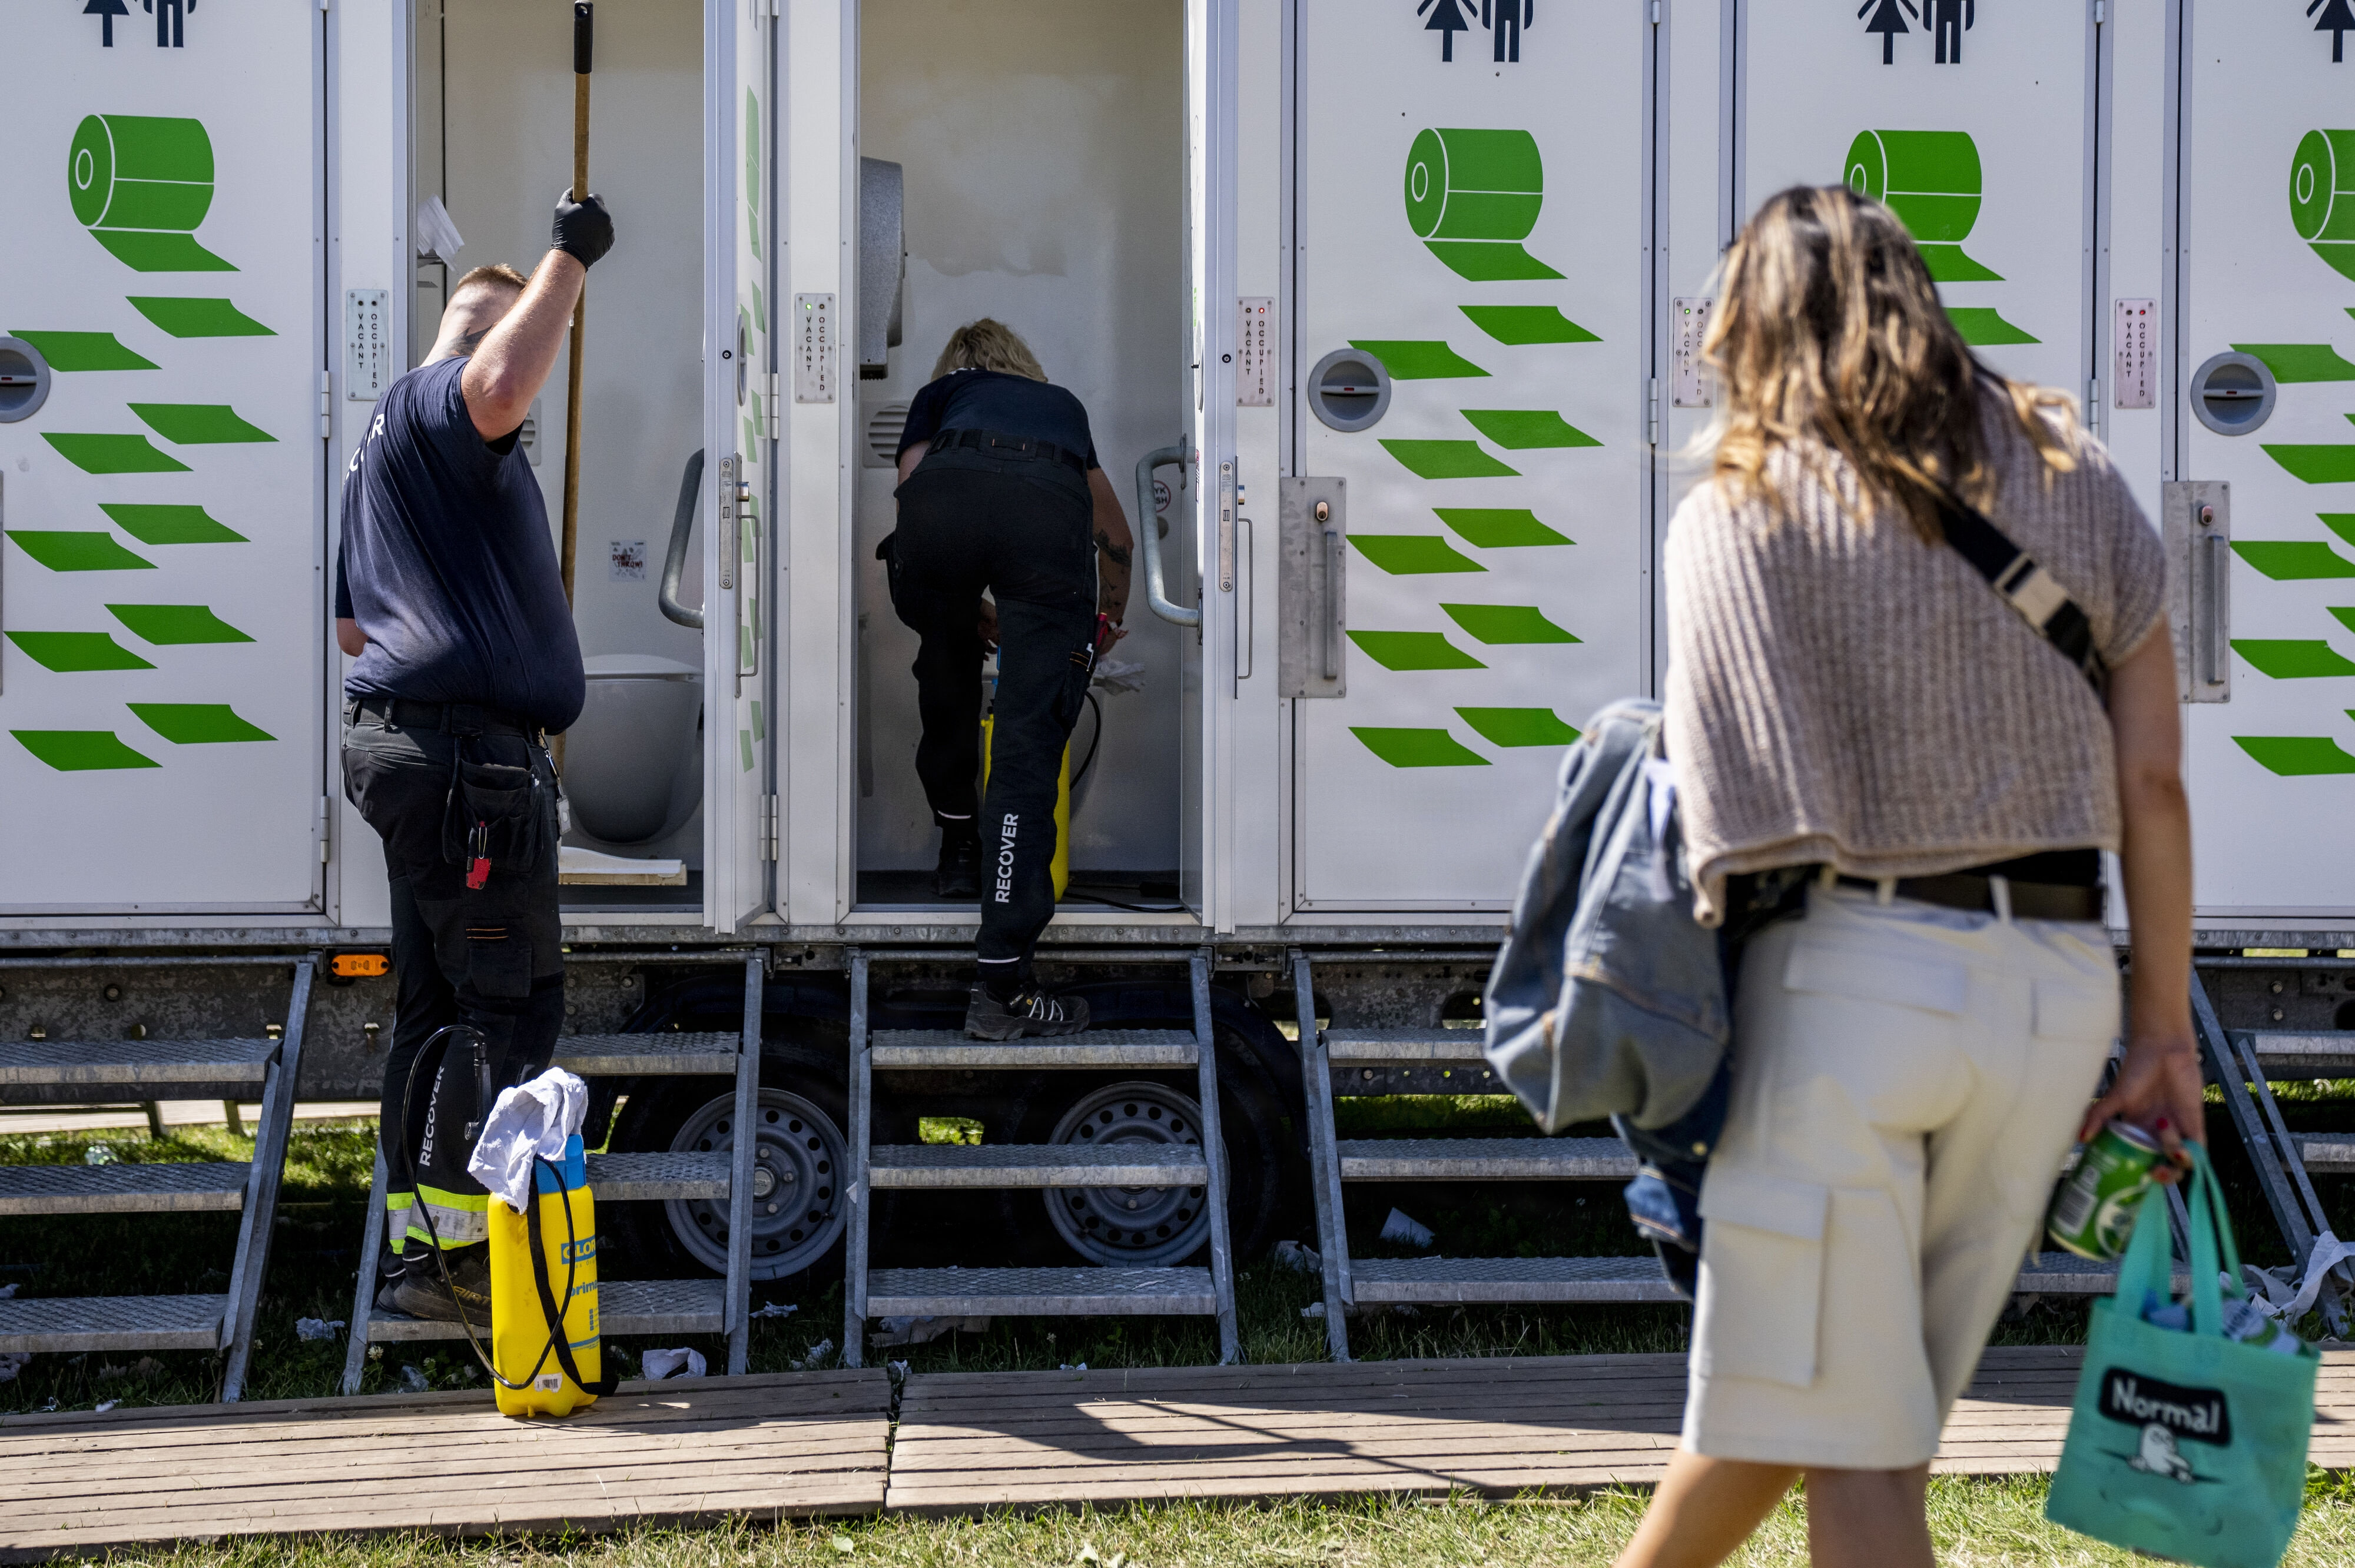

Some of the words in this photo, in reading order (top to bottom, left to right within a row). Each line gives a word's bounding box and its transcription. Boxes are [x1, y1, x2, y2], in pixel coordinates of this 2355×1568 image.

[995, 813, 1019, 903] RECOVER
[419, 1065, 445, 1167] RECOVER
[2112, 1377, 2221, 1435] Normal
